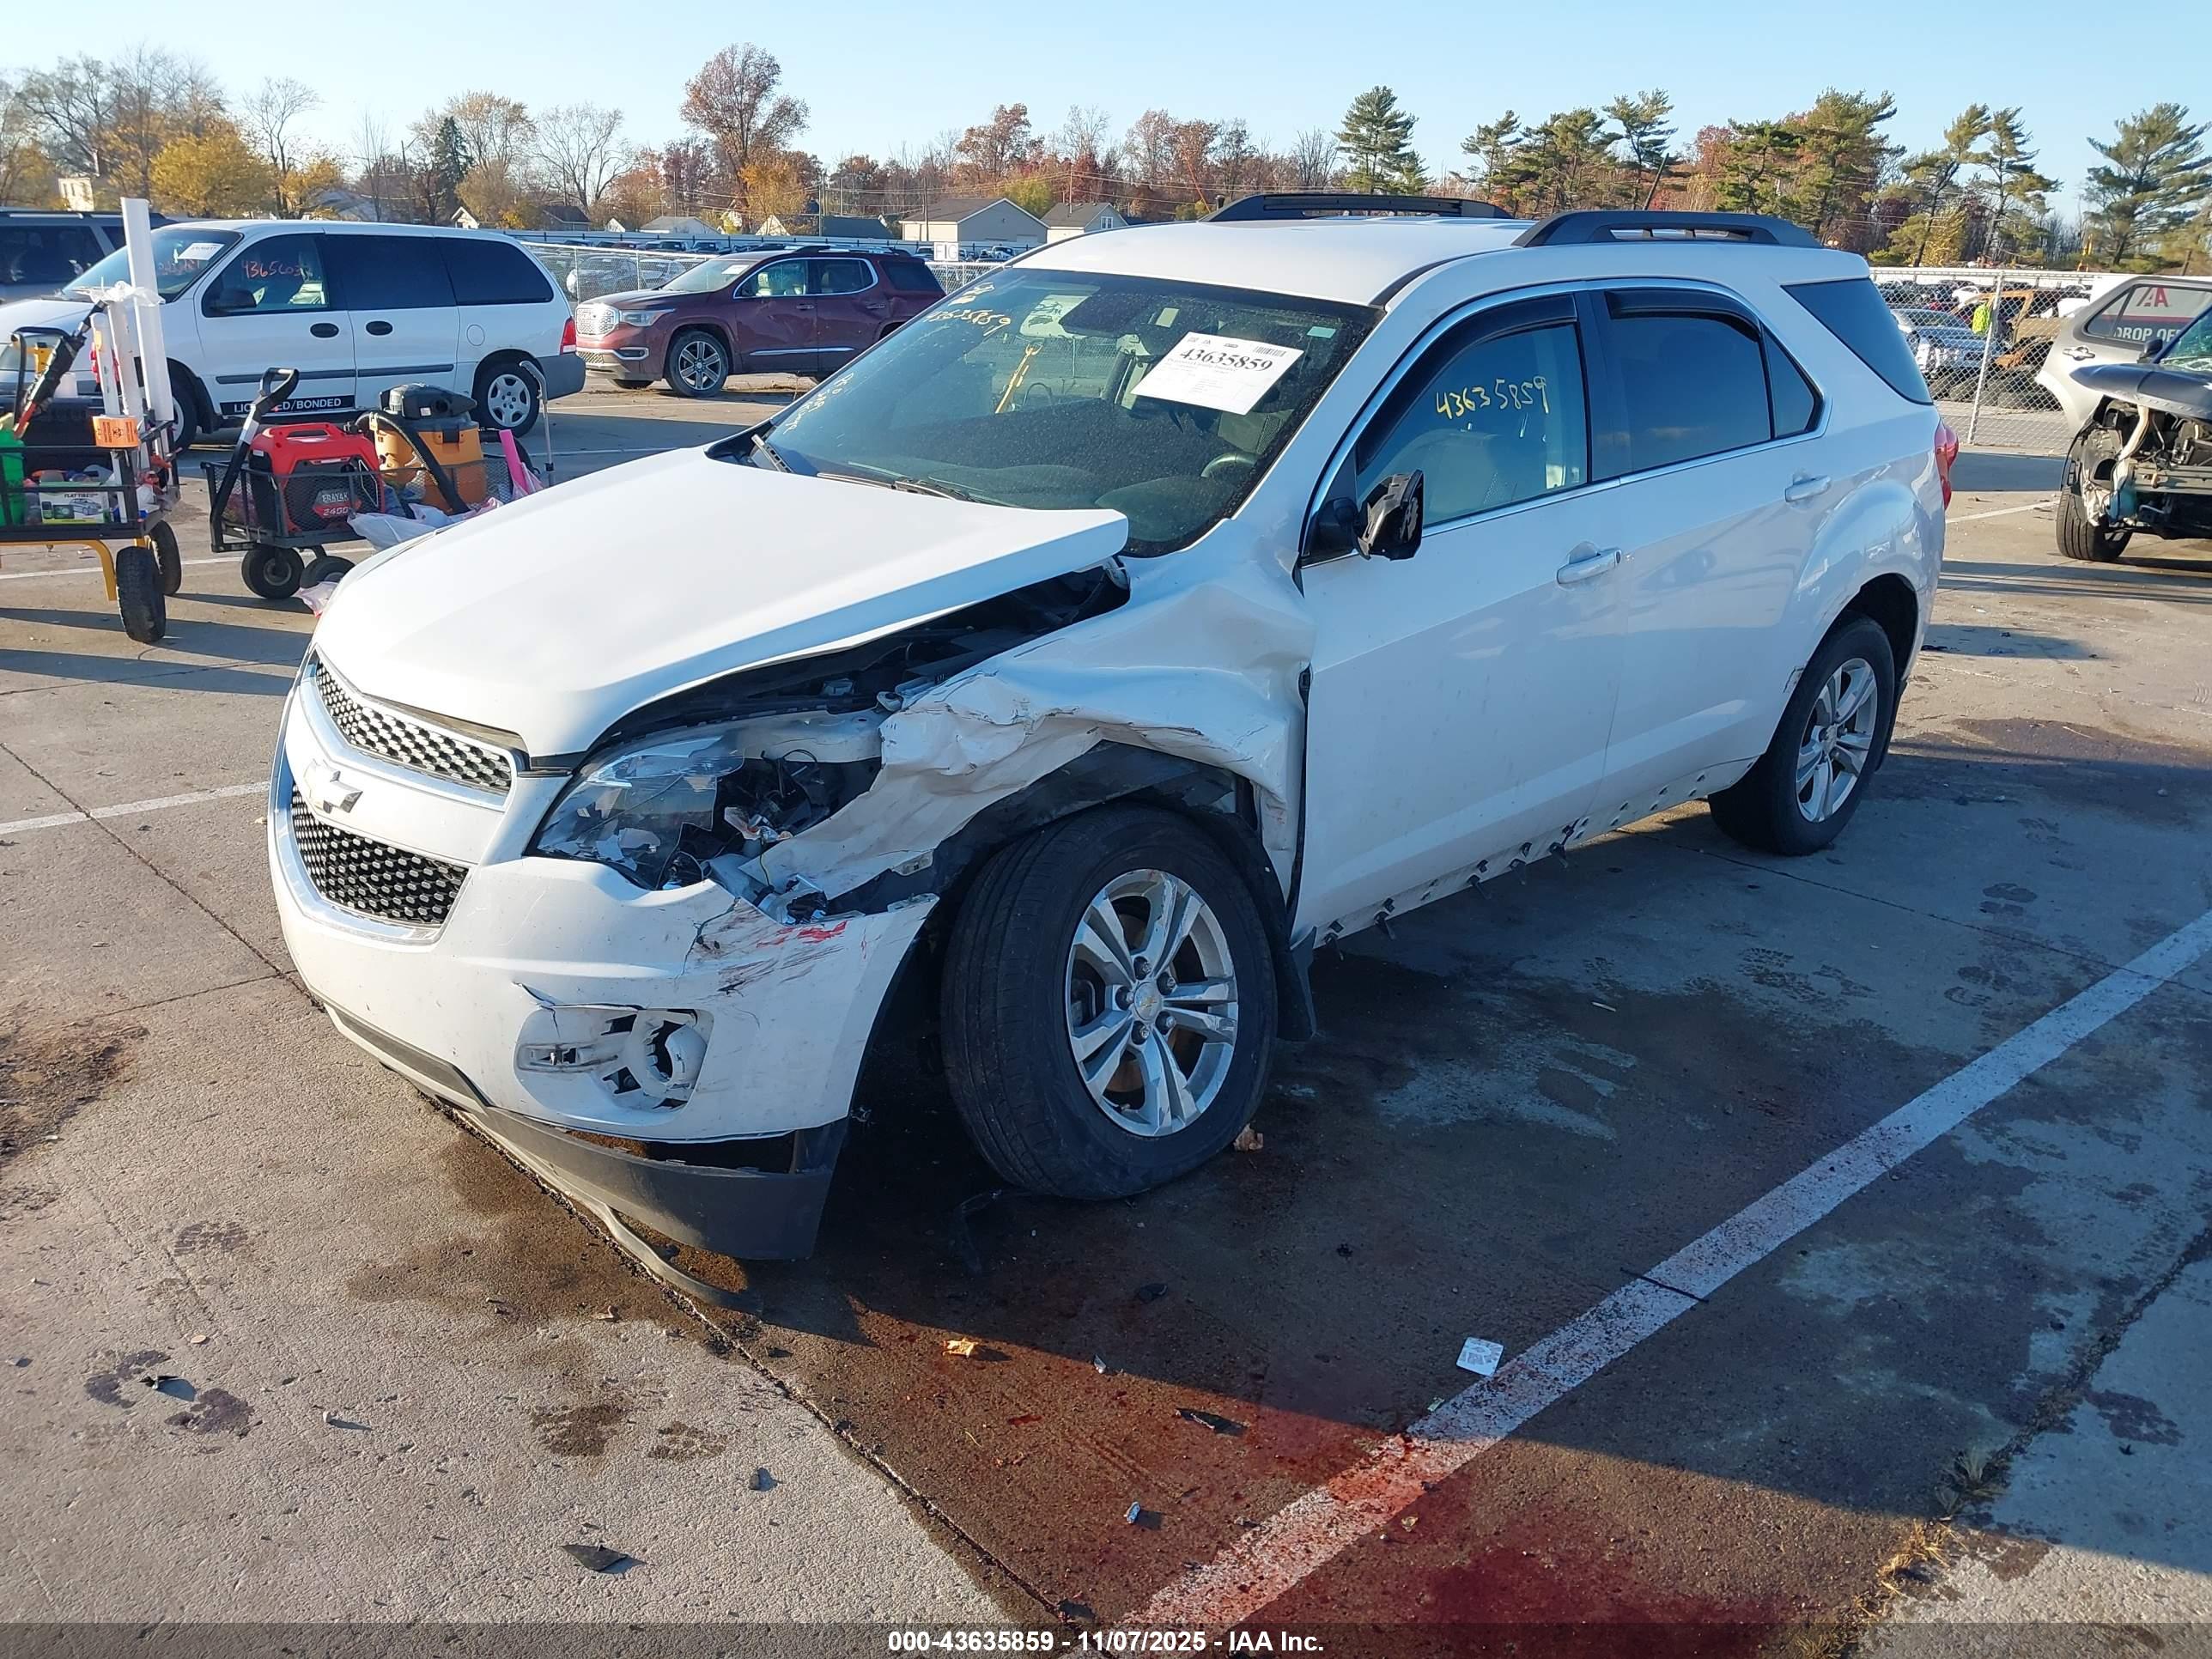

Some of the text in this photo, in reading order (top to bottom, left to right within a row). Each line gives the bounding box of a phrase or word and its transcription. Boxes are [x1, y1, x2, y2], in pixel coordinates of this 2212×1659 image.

[935, 244, 957, 259] FIG
[1179, 348, 1273, 372] 43635859
[1436, 375, 1549, 420] 43635859
[322, 506, 349, 516] 2400
